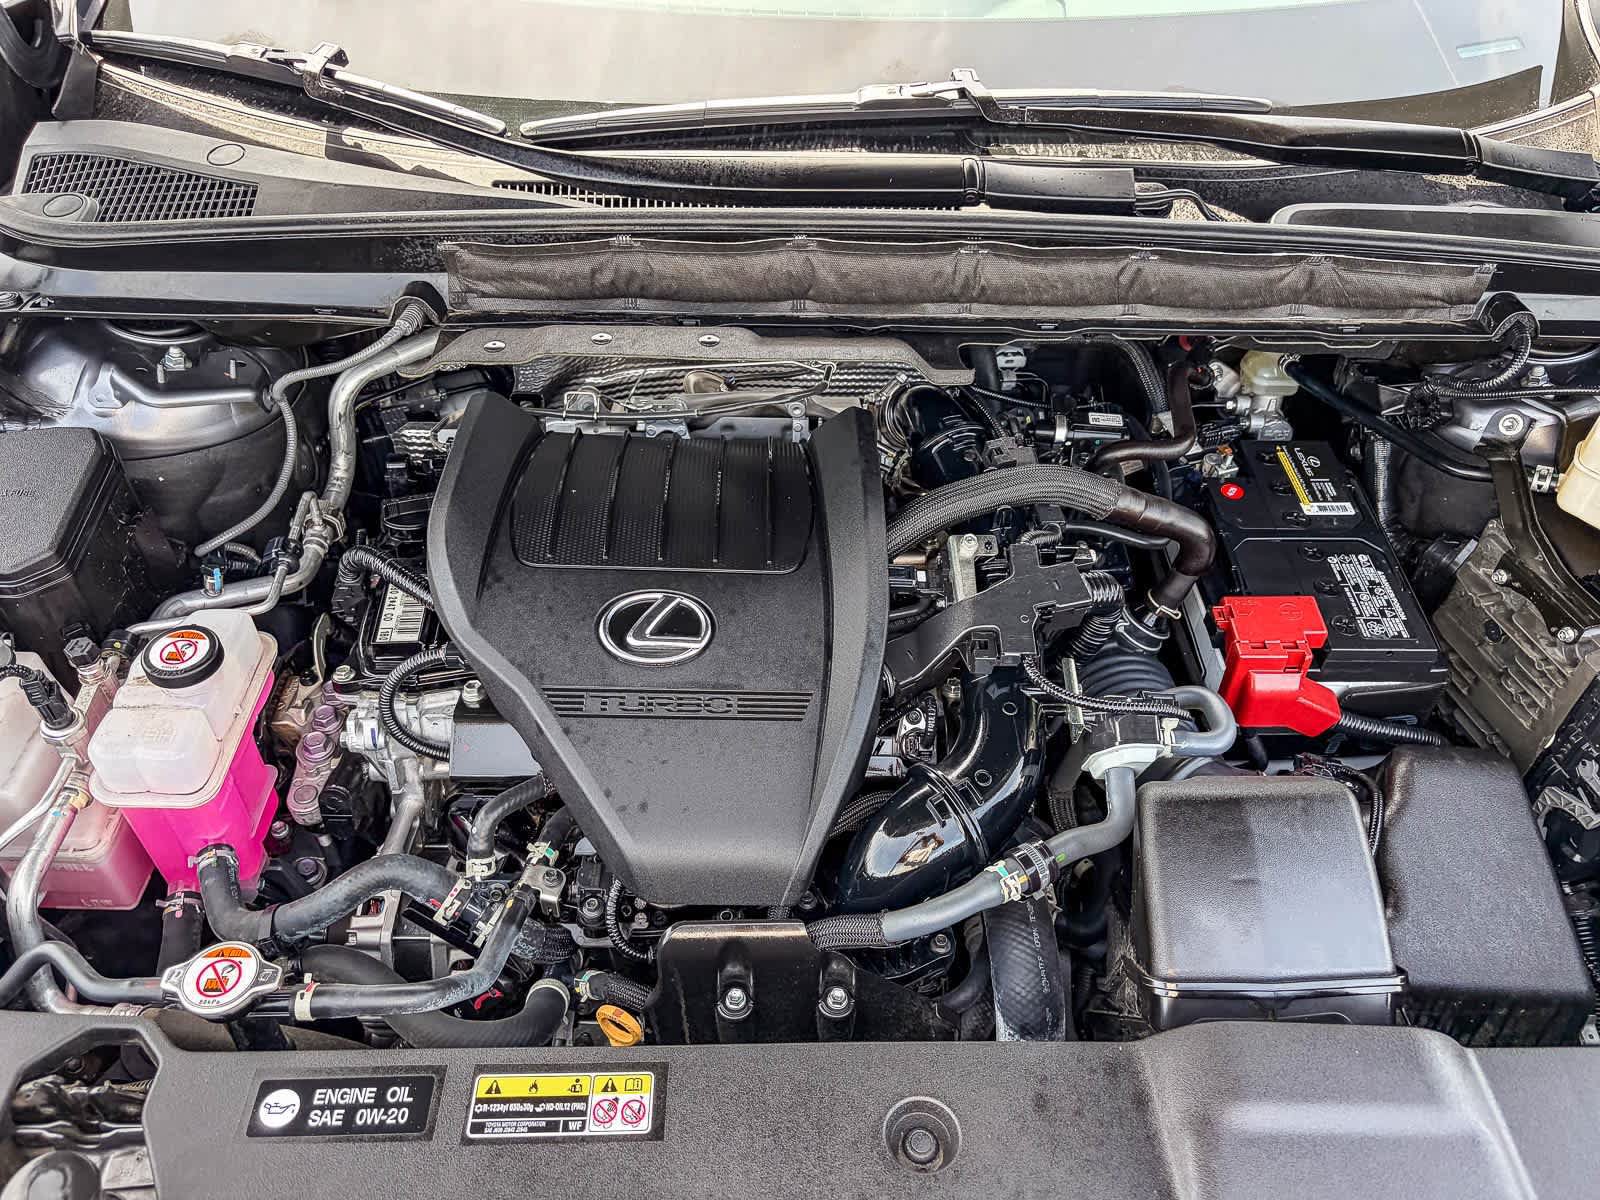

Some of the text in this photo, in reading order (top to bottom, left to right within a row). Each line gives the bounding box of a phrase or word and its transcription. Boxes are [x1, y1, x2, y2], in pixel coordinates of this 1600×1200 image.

[1294, 447, 1314, 477] LEXUS
[588, 694, 733, 713] TURBO
[313, 1086, 413, 1105] ENGINE OIL
[307, 1107, 409, 1127] SAE 0W-20
[568, 1121, 582, 1130] WF
